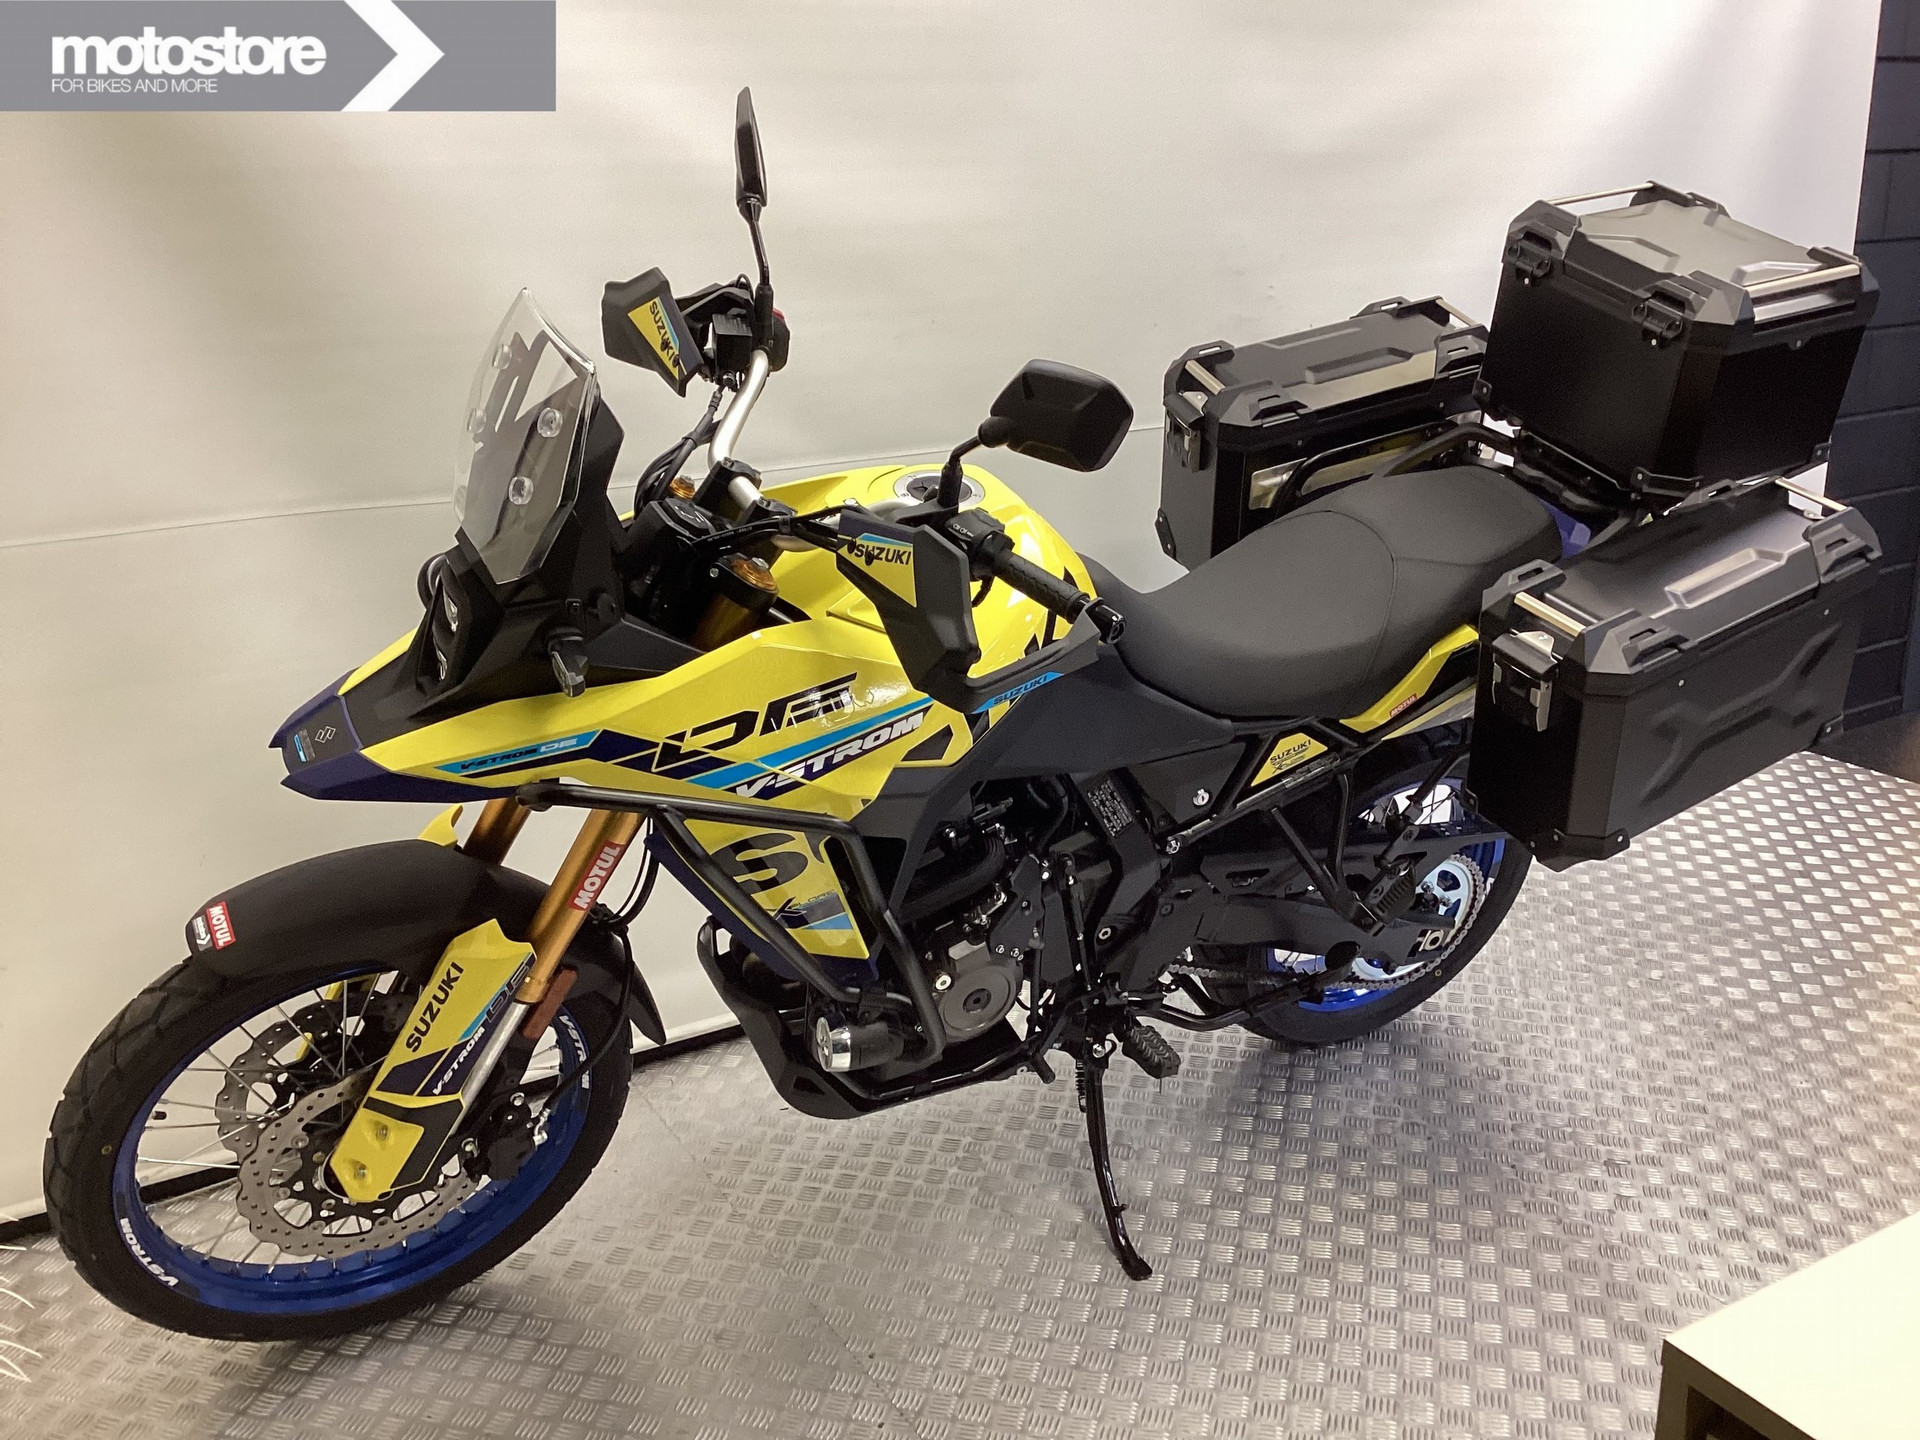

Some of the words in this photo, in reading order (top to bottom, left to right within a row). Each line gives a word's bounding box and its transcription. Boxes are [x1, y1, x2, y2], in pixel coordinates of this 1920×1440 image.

[649, 301, 677, 362] SUZUKI
[854, 543, 911, 566] SUZUKI
[993, 675, 1048, 705] SUZUKI
[1390, 695, 1416, 717] MOTUL
[460, 747, 537, 770] V-STROM
[735, 711, 925, 799] V-STROM
[1269, 739, 1312, 762] SUZUKI
[573, 845, 621, 910] MOTUL
[208, 905, 232, 947] MOTUL
[405, 961, 464, 1053] SUZUKI
[432, 1026, 486, 1096] V-STROM
[119, 1217, 179, 1287] V-STROM
